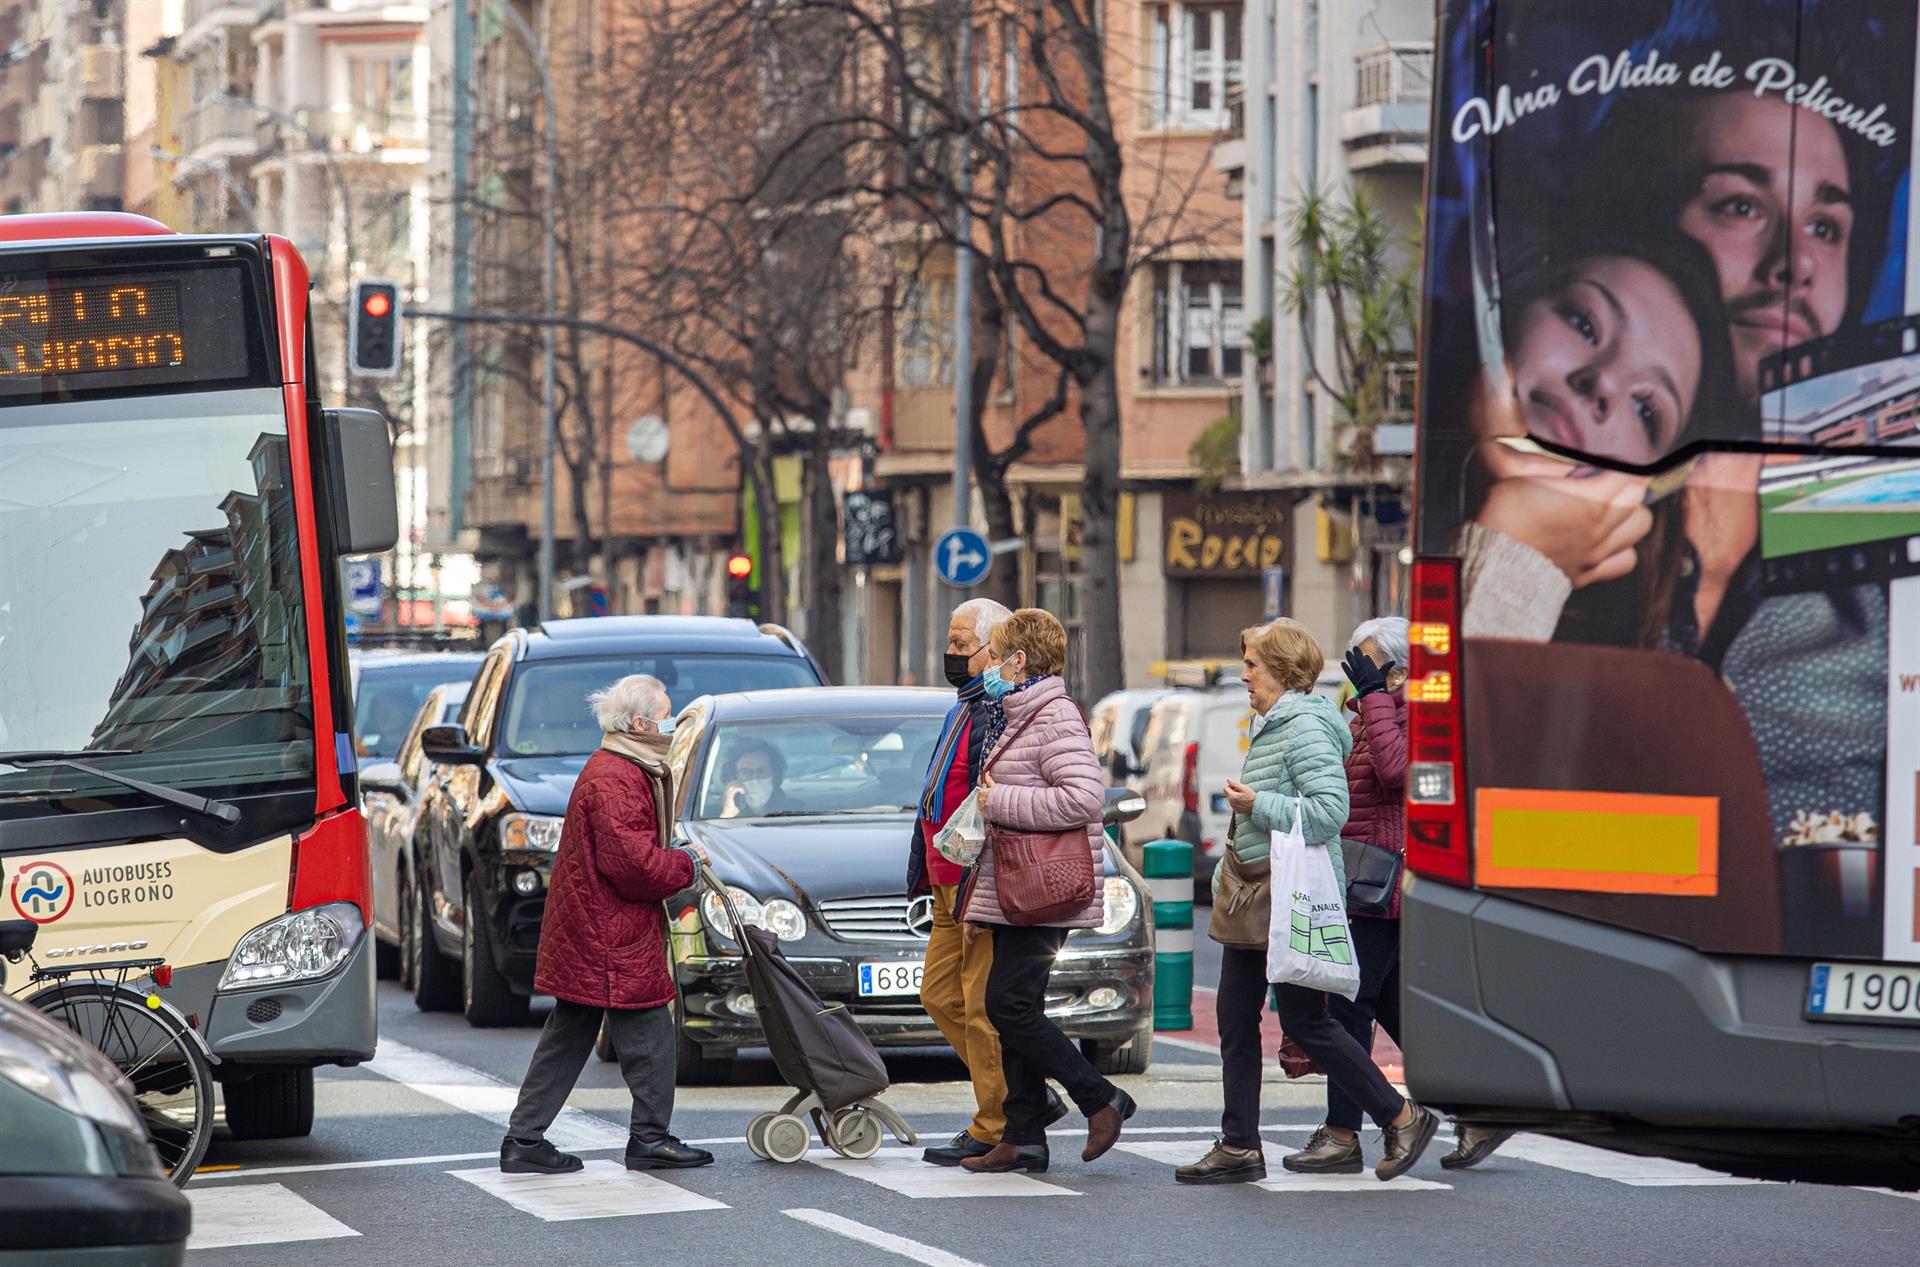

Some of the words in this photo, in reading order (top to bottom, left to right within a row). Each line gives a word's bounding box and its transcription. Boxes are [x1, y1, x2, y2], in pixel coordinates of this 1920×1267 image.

[1451, 83, 1561, 144] Una
[1567, 49, 1681, 97] Vida
[1689, 51, 1736, 91] de
[83, 861, 172, 886] AUTOBUSES
[84, 880, 173, 908] LOGROÑO
[46, 940, 148, 958] CITARO
[1843, 972, 1920, 1014] 190
